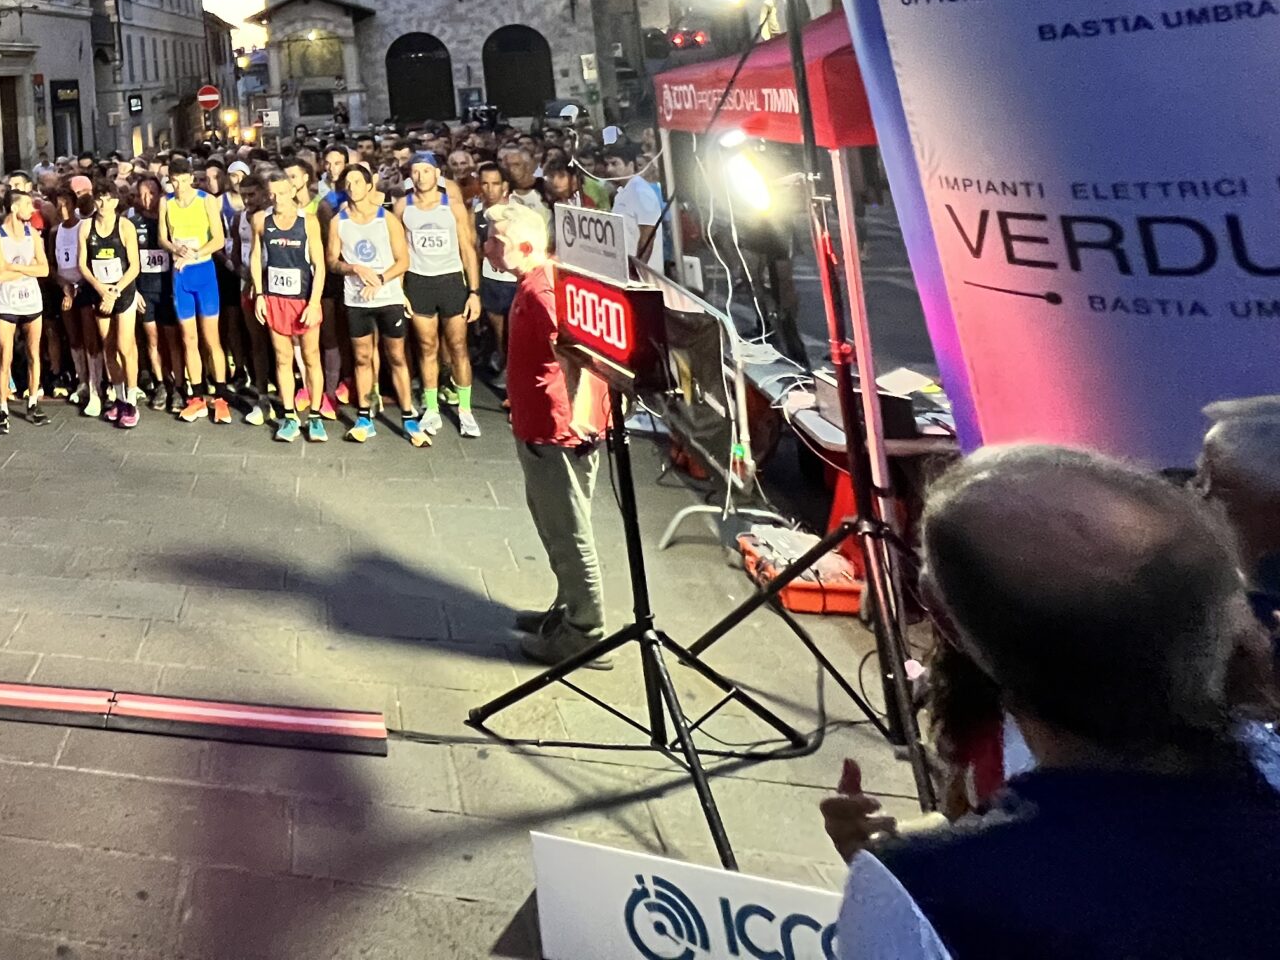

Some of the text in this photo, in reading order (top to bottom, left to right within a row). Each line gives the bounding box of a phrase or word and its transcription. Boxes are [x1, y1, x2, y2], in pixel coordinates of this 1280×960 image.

[1038, 14, 1154, 41] BASTIA
[762, 88, 800, 114] TIMIN
[938, 175, 1248, 201] IMPIANTI ELETTRICI
[420, 236, 443, 248] 255
[64, 251, 70, 262] 3
[273, 275, 293, 288] 246
[1088, 294, 1211, 318] BASTIA
